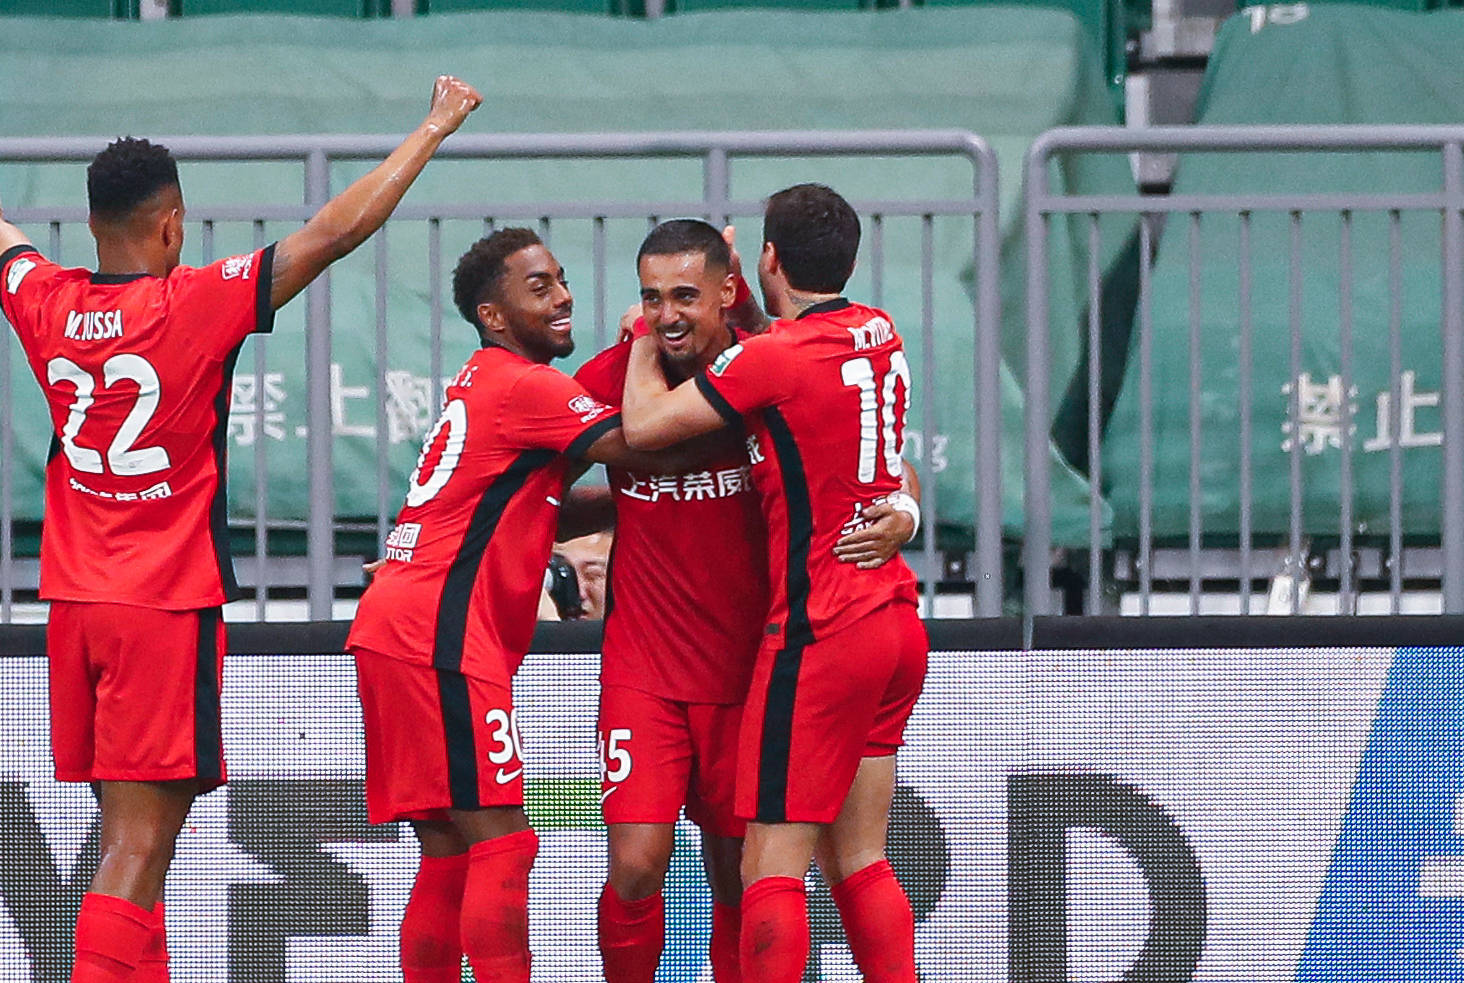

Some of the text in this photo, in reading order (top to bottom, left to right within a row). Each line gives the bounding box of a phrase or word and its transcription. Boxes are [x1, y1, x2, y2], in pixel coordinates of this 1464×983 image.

[47, 353, 171, 476] 22
[841, 351, 911, 484] 10
[1281, 371, 1444, 454] 禁止
